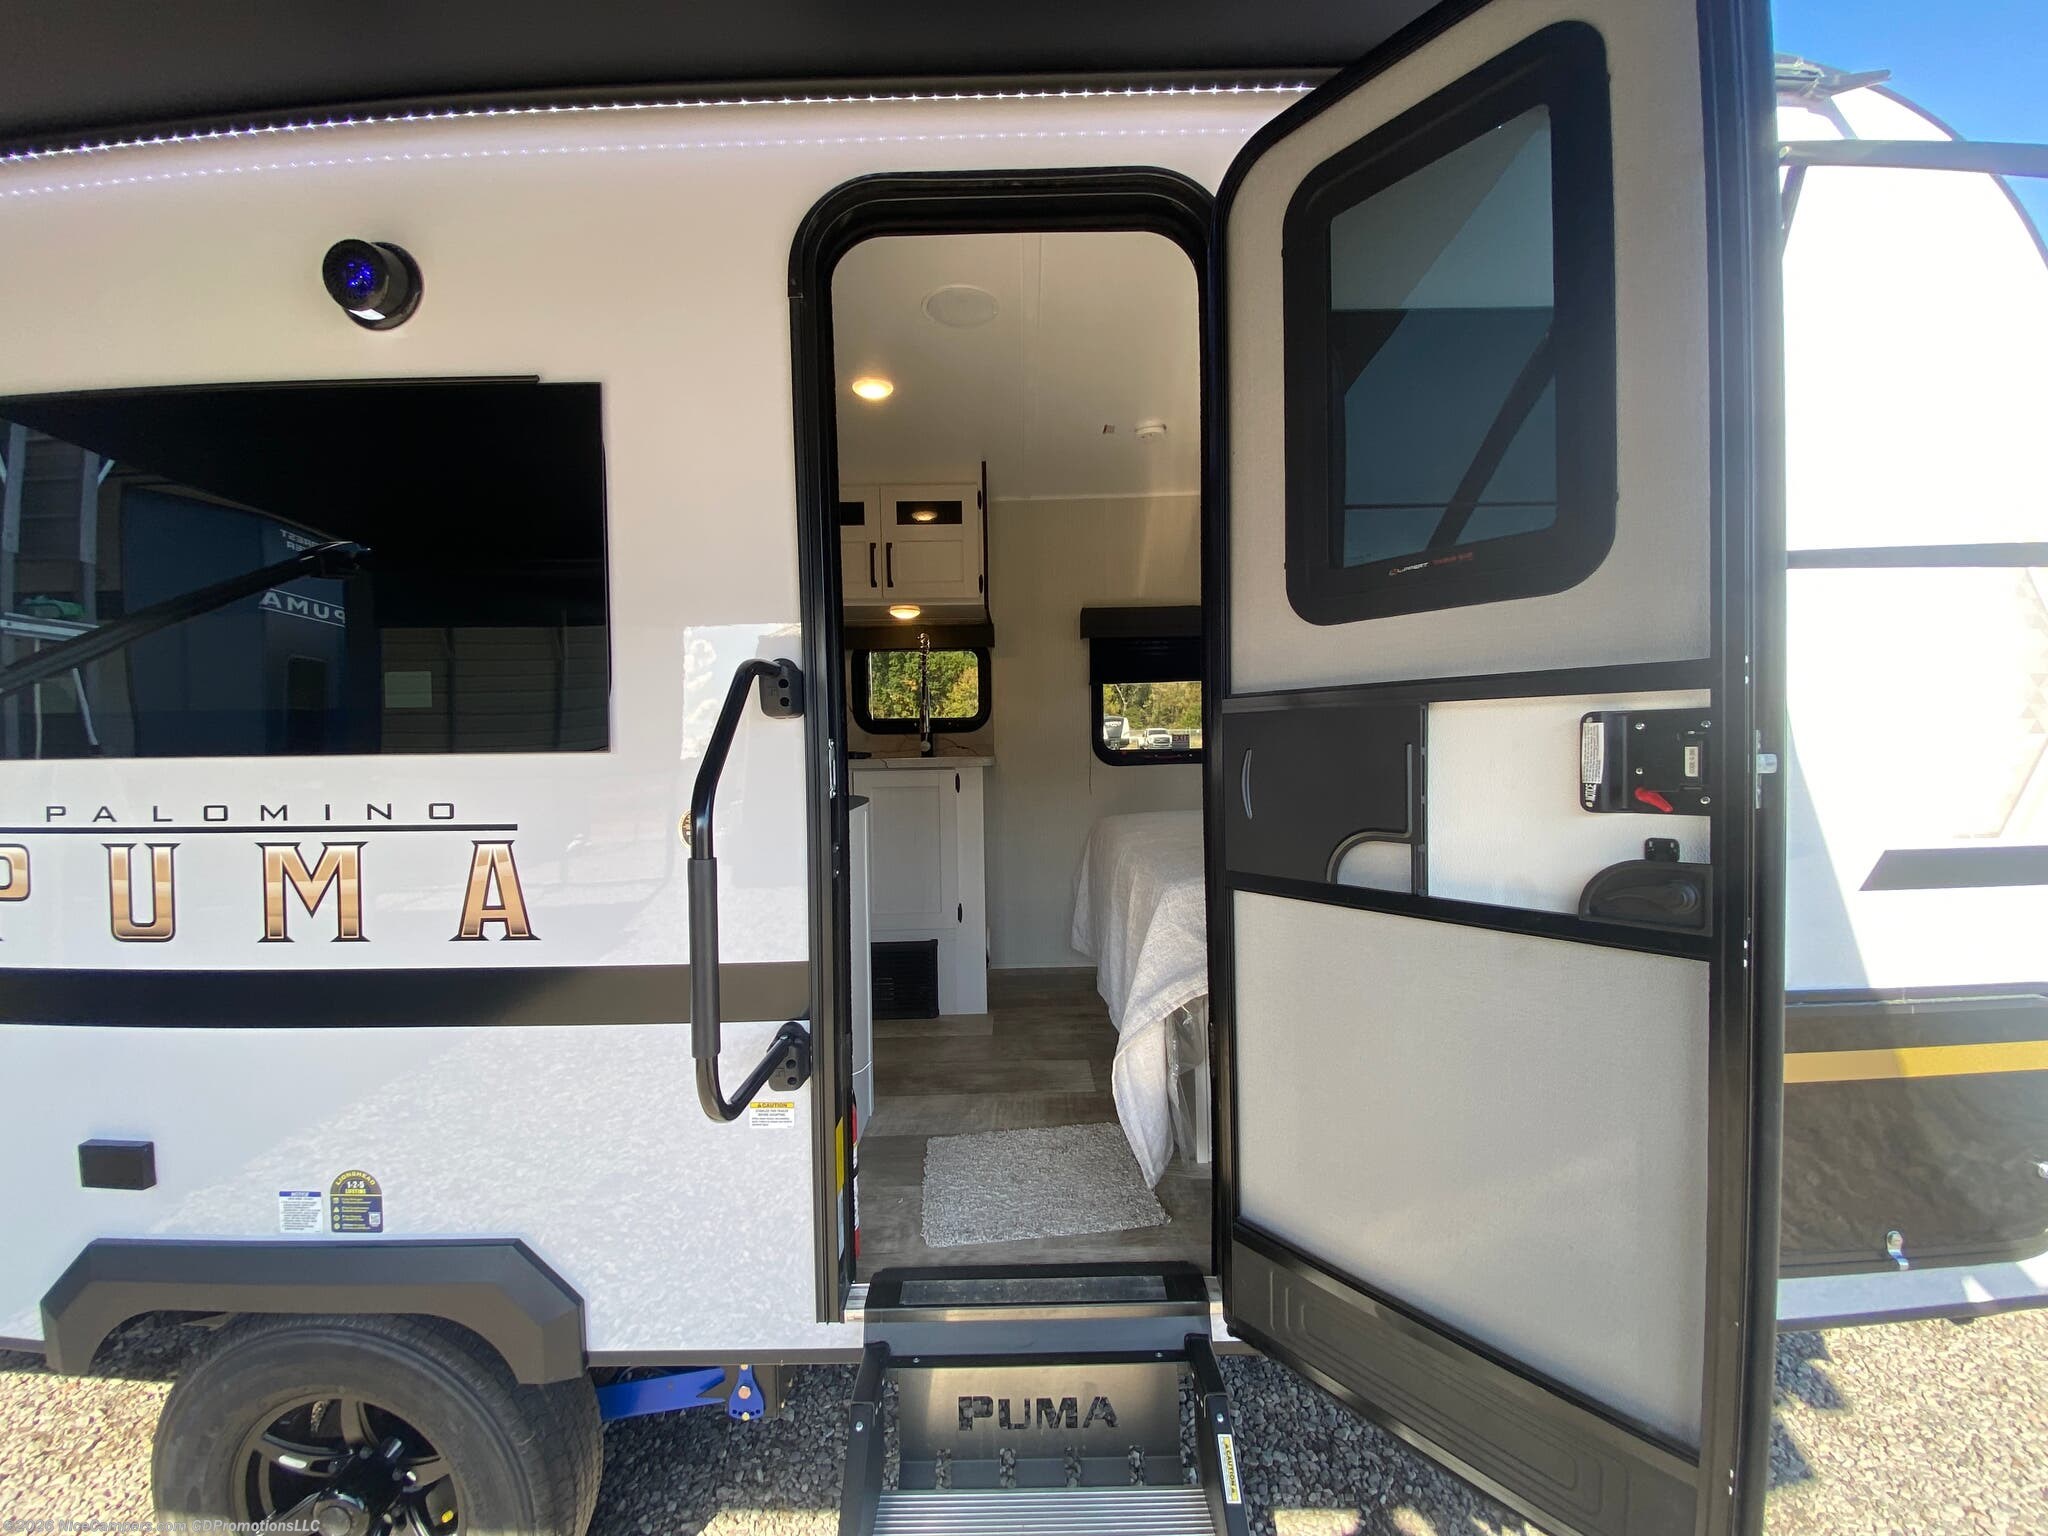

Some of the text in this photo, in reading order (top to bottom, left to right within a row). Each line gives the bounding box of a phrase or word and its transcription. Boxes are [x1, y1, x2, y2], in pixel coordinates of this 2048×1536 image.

[45, 802, 456, 823] PALOMINO
[957, 1394, 1119, 1432] PUMA
[1226, 1451, 1236, 1489] CAUTION
